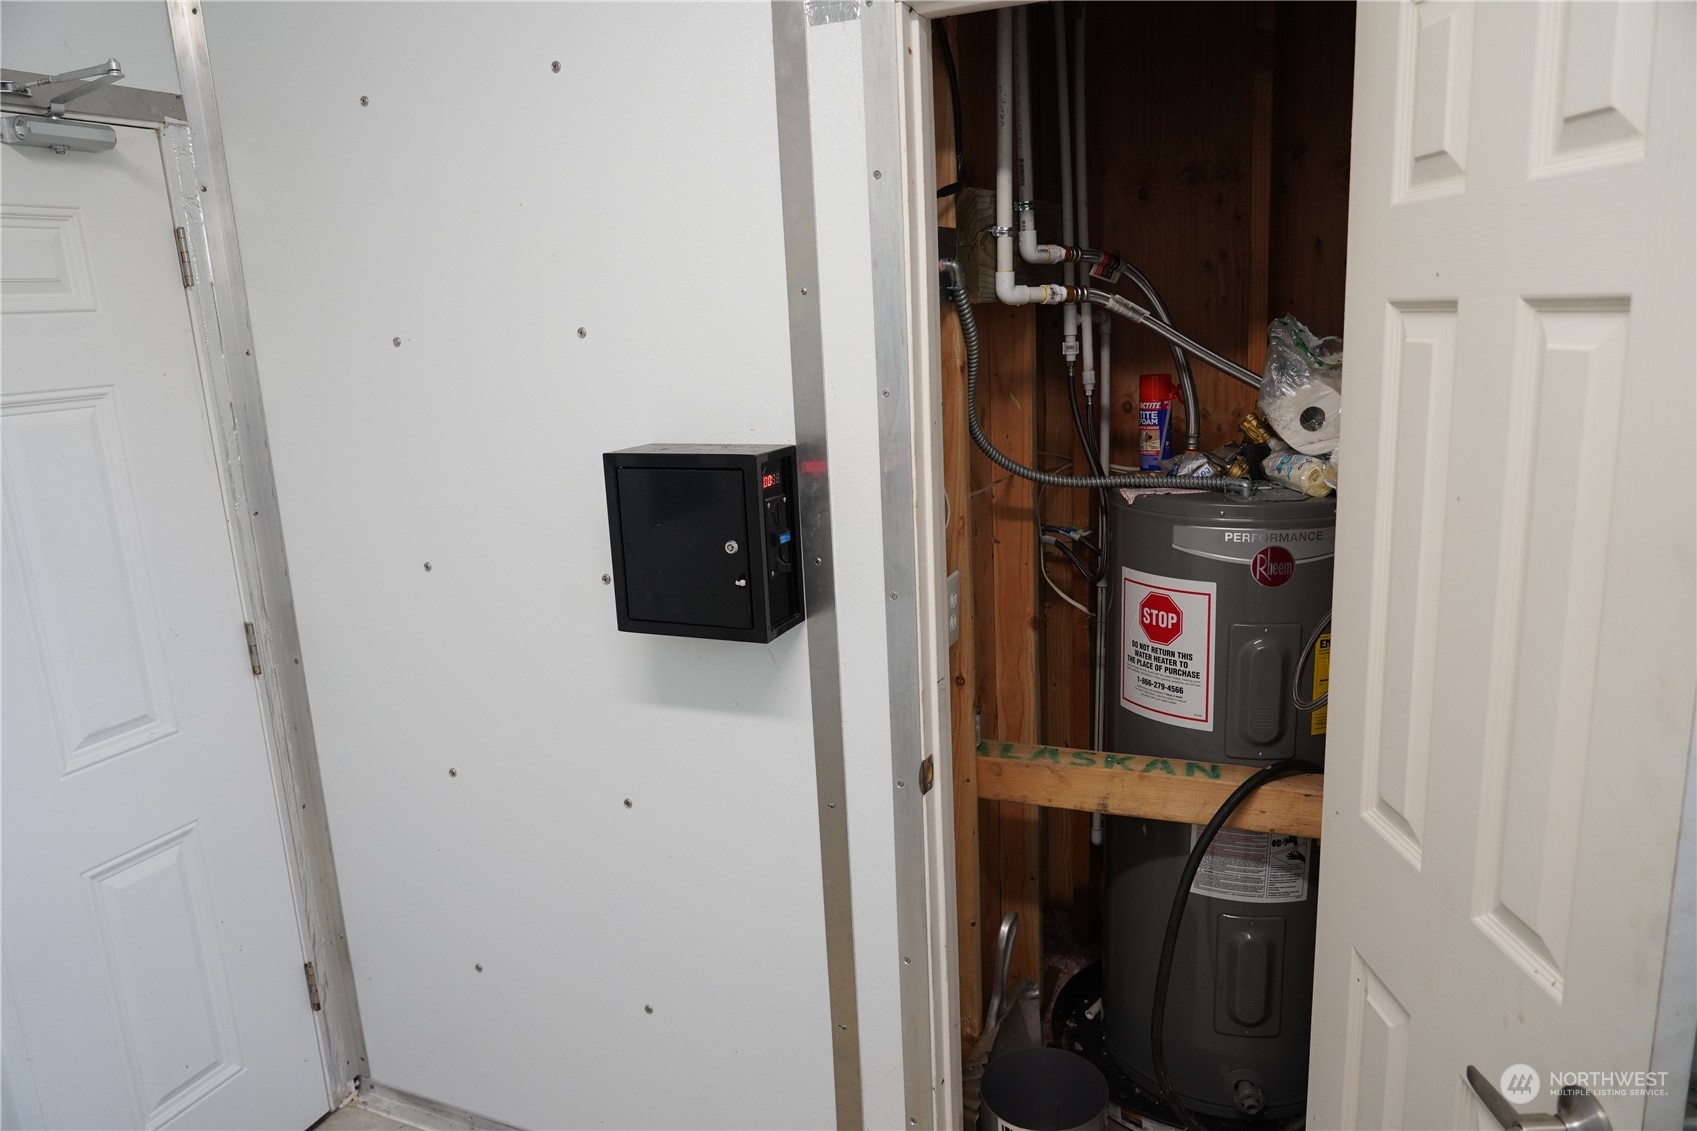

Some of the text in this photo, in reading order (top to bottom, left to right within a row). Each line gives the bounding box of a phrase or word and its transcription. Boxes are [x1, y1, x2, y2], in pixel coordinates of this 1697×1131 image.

[1225, 531, 1323, 542] PERFORMANCE
[1256, 548, 1292, 581] Rheem
[1143, 608, 1178, 628] STOP
[1132, 640, 1193, 660] DO NOT RETURN THIS
[1134, 650, 1188, 668] WATER HEATER TO
[1127, 654, 1136, 664] THE
[1137, 658, 1153, 670] PLACE
[1155, 663, 1162, 672] OF
[1164, 667, 1200, 679] PURCHASE
[1137, 676, 1184, 694] 1-866-279-4566
